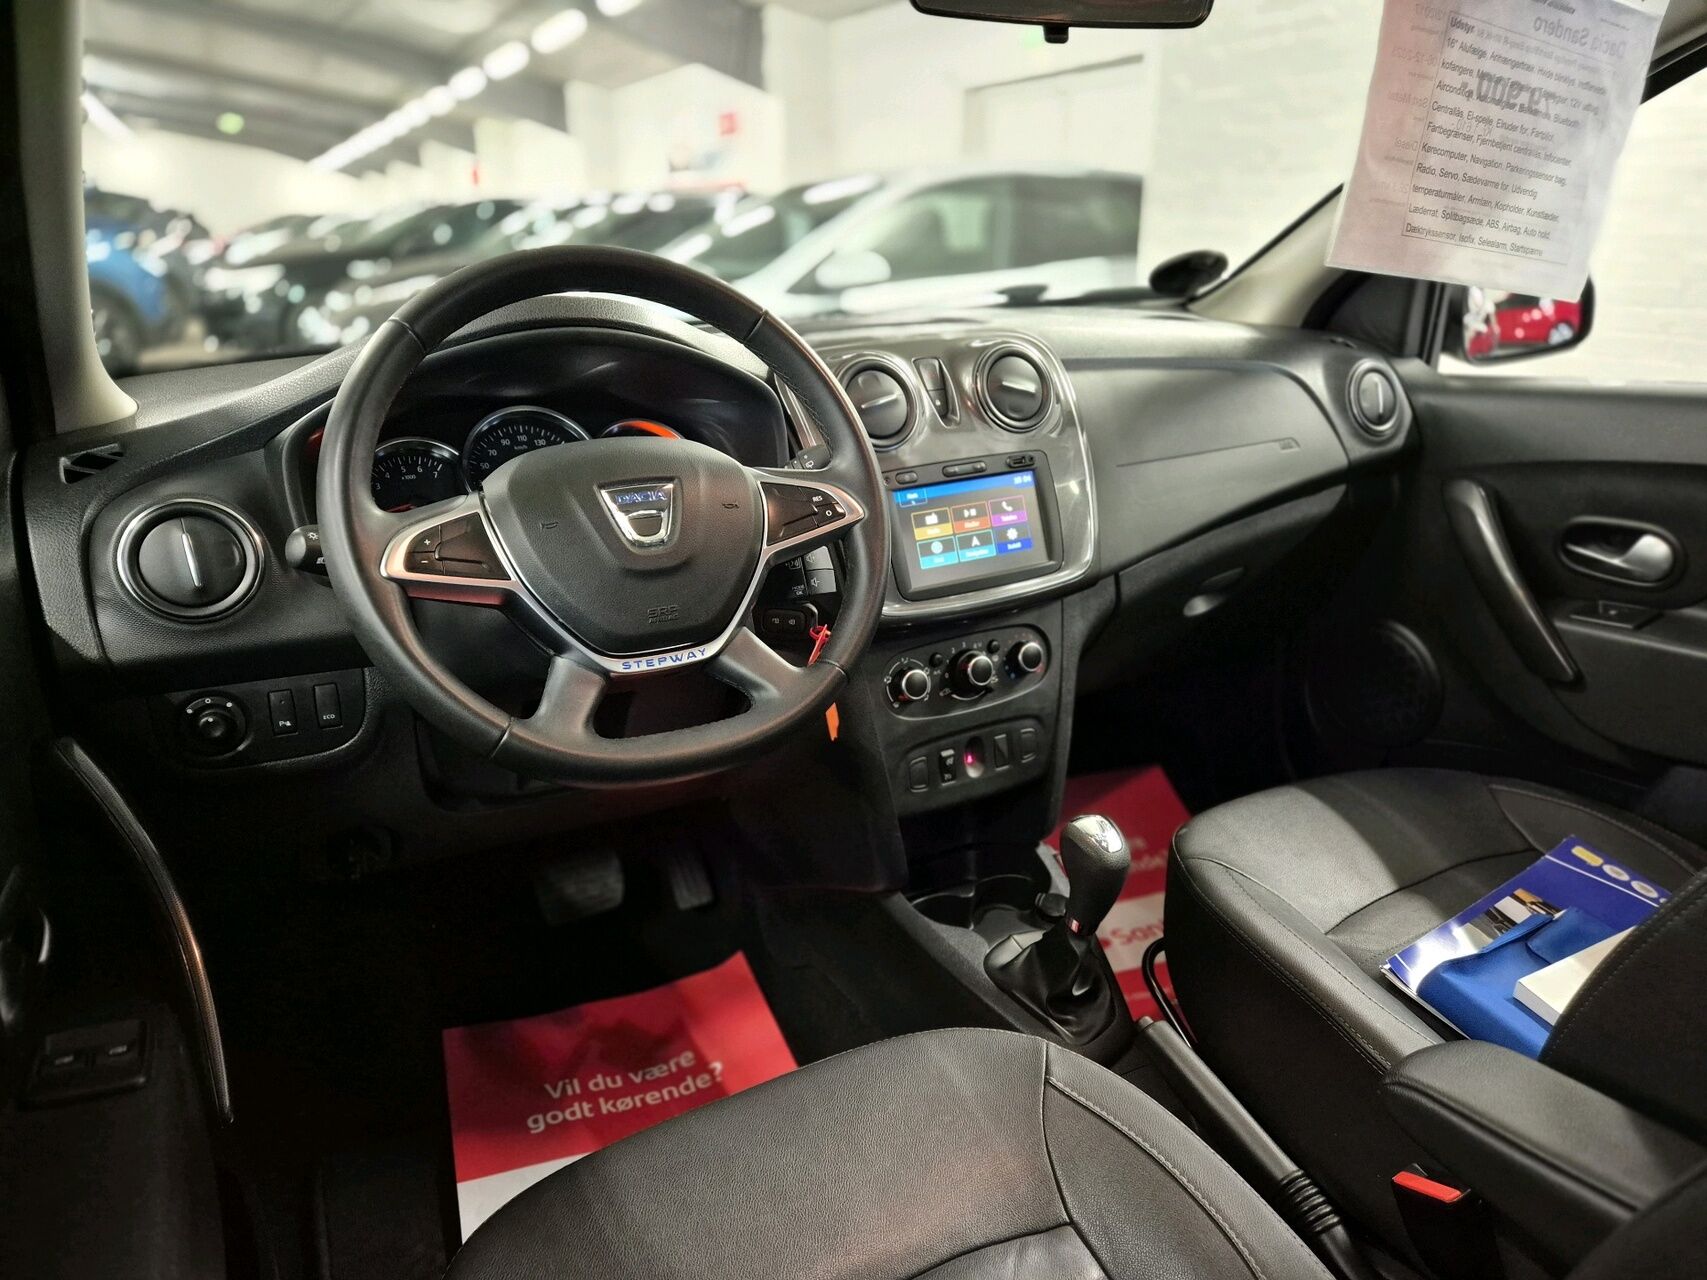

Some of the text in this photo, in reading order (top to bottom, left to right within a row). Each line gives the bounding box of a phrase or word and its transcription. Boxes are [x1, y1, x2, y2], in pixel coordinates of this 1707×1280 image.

[615, 489, 668, 505] DACIA
[622, 647, 707, 670] STEPWAY
[544, 1049, 697, 1100] Vil du være
[526, 1061, 726, 1134] godt kørende?
